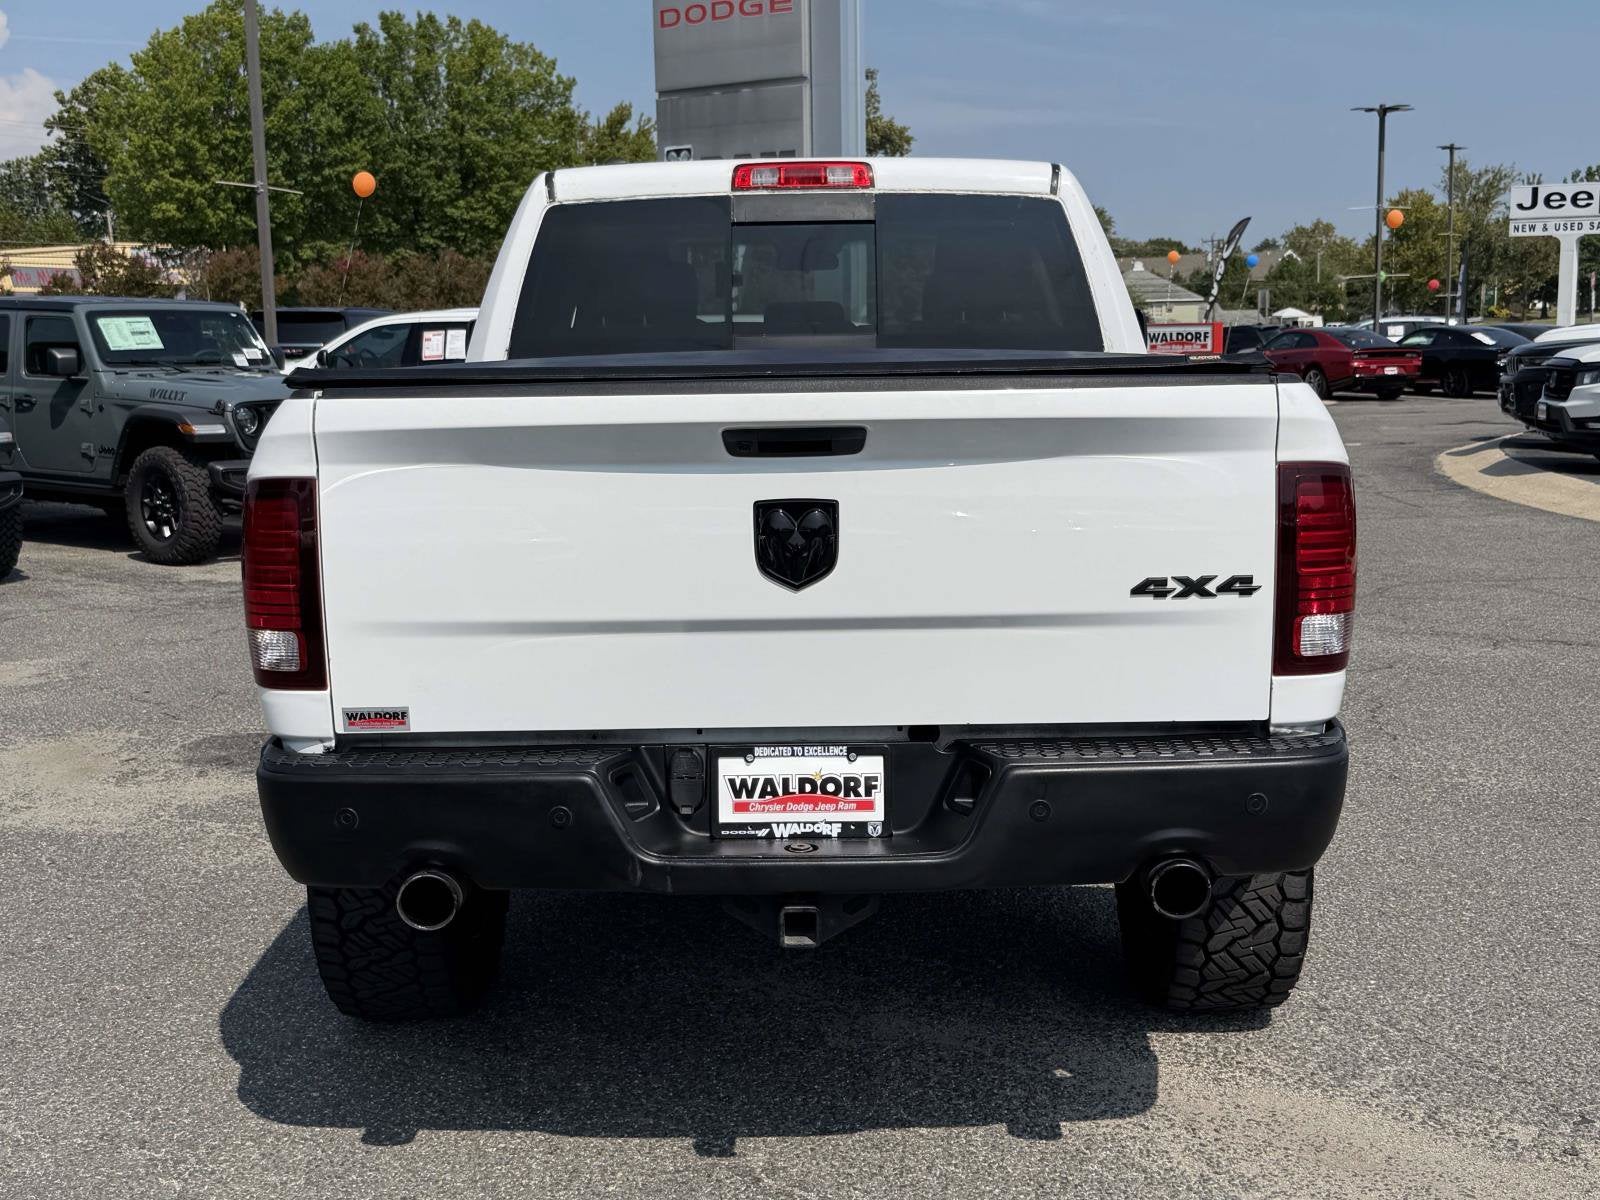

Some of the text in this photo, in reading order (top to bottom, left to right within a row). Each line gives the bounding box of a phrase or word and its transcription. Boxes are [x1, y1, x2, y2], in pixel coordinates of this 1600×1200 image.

[659, 0, 793, 29] DODGE
[1516, 186, 1600, 211] Jee
[1513, 224, 1536, 233] NEW
[1542, 223, 1548, 232] &
[1554, 222, 1583, 232] USED
[1148, 331, 1210, 343] WALDORF
[345, 711, 408, 721] WALDORF
[754, 745, 848, 757] DEDICATED TO EXCELLENCE
[727, 776, 879, 799] WALDORF
[749, 801, 857, 813] Chrysler Dodge Jeep Ram
[771, 823, 842, 838] WALDORF
